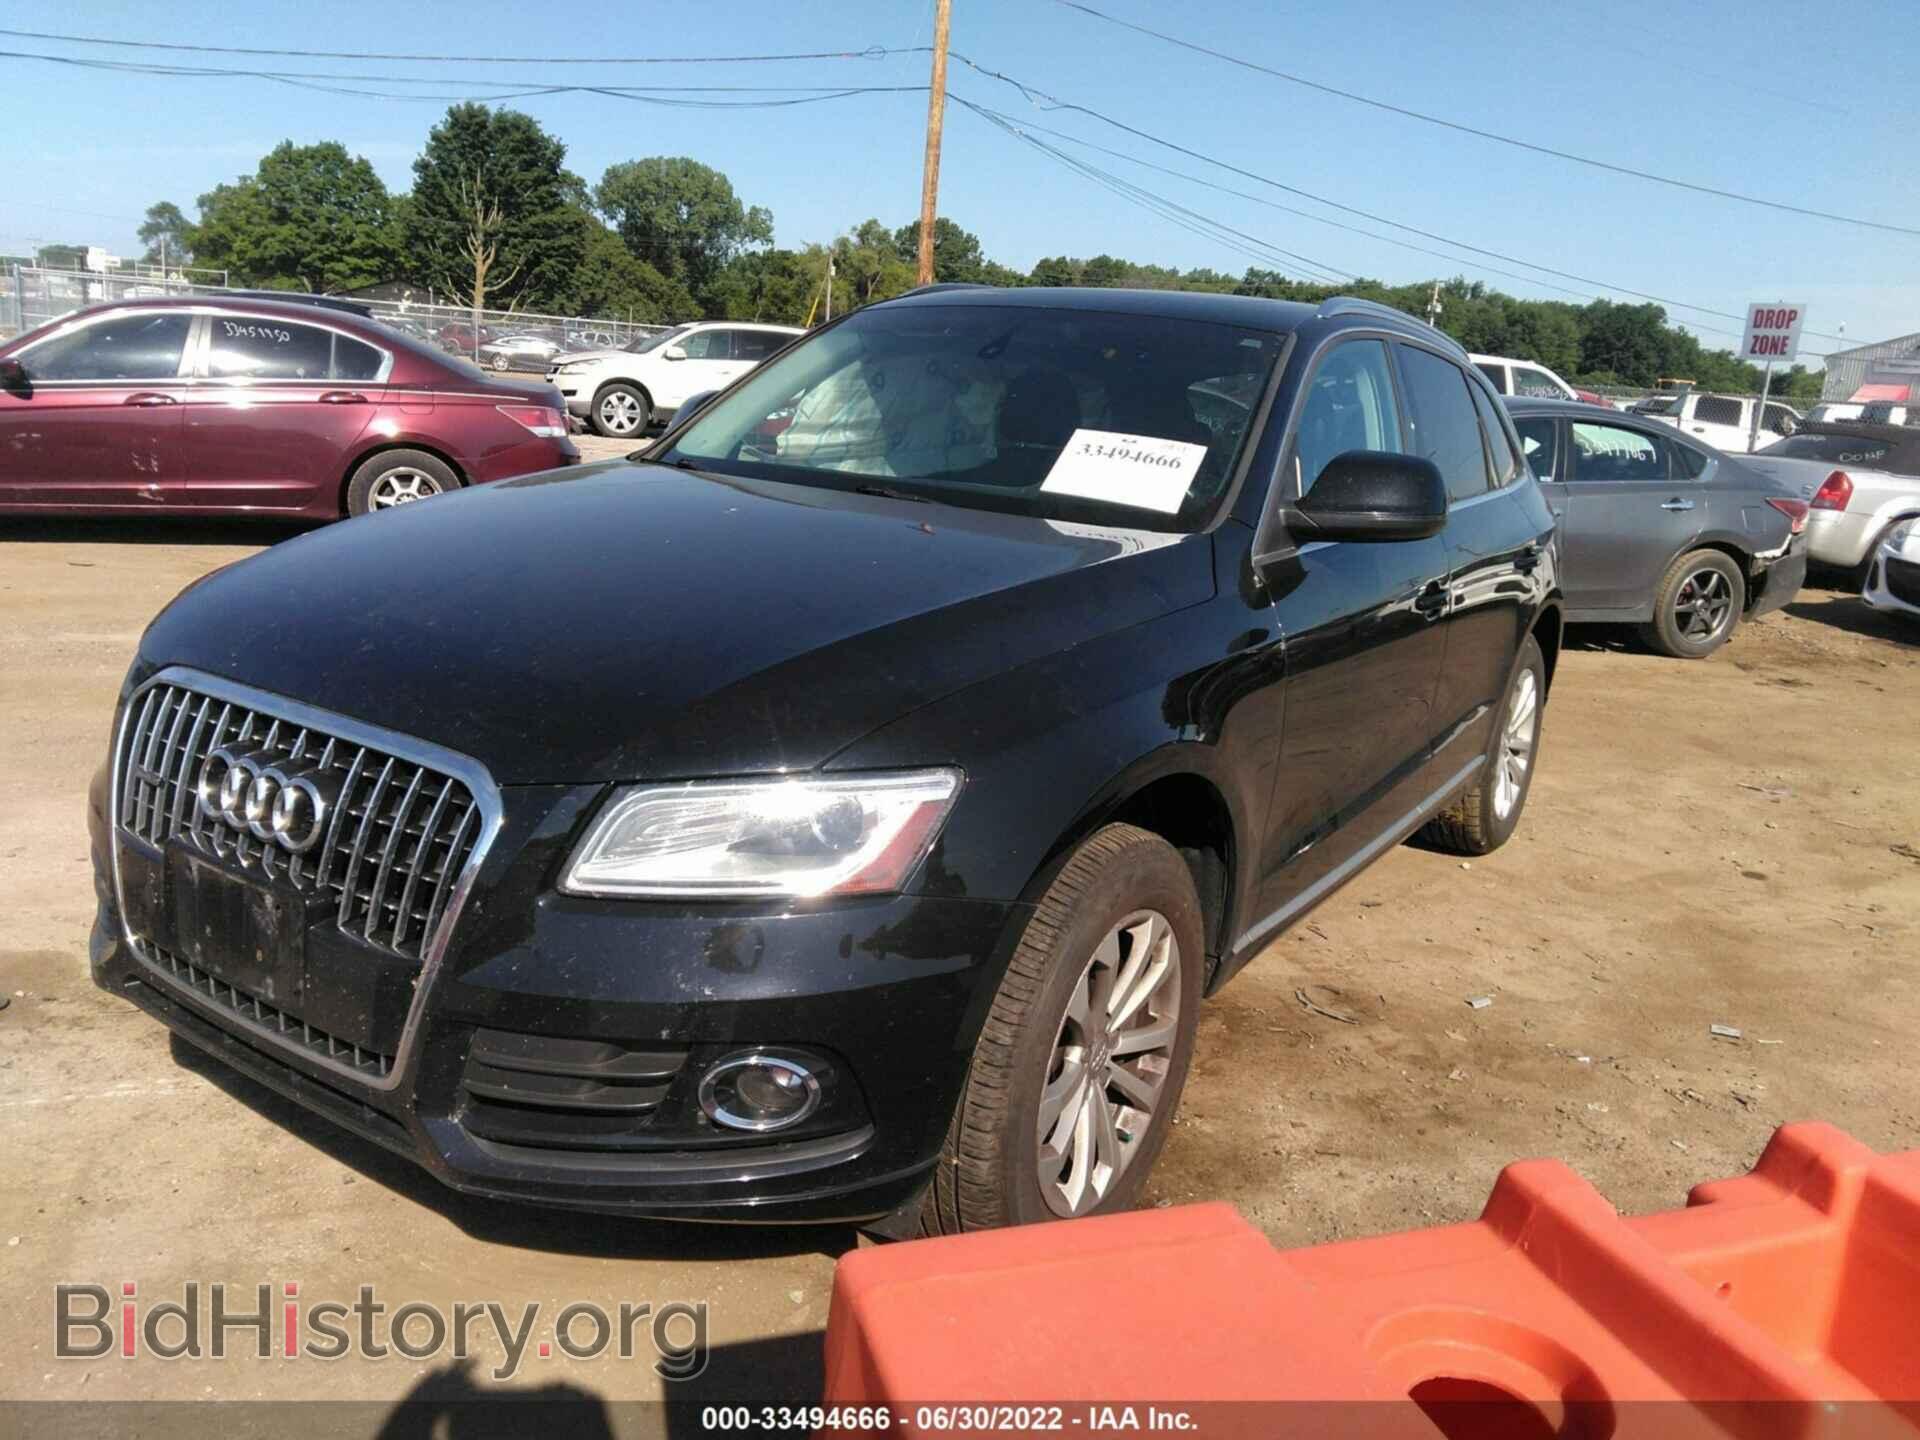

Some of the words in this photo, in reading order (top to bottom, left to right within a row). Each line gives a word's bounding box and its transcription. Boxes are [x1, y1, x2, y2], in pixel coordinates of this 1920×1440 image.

[1753, 309, 1798, 329] DROP
[1750, 335, 1789, 355] ZONE
[1076, 443, 1182, 470] 33494666
